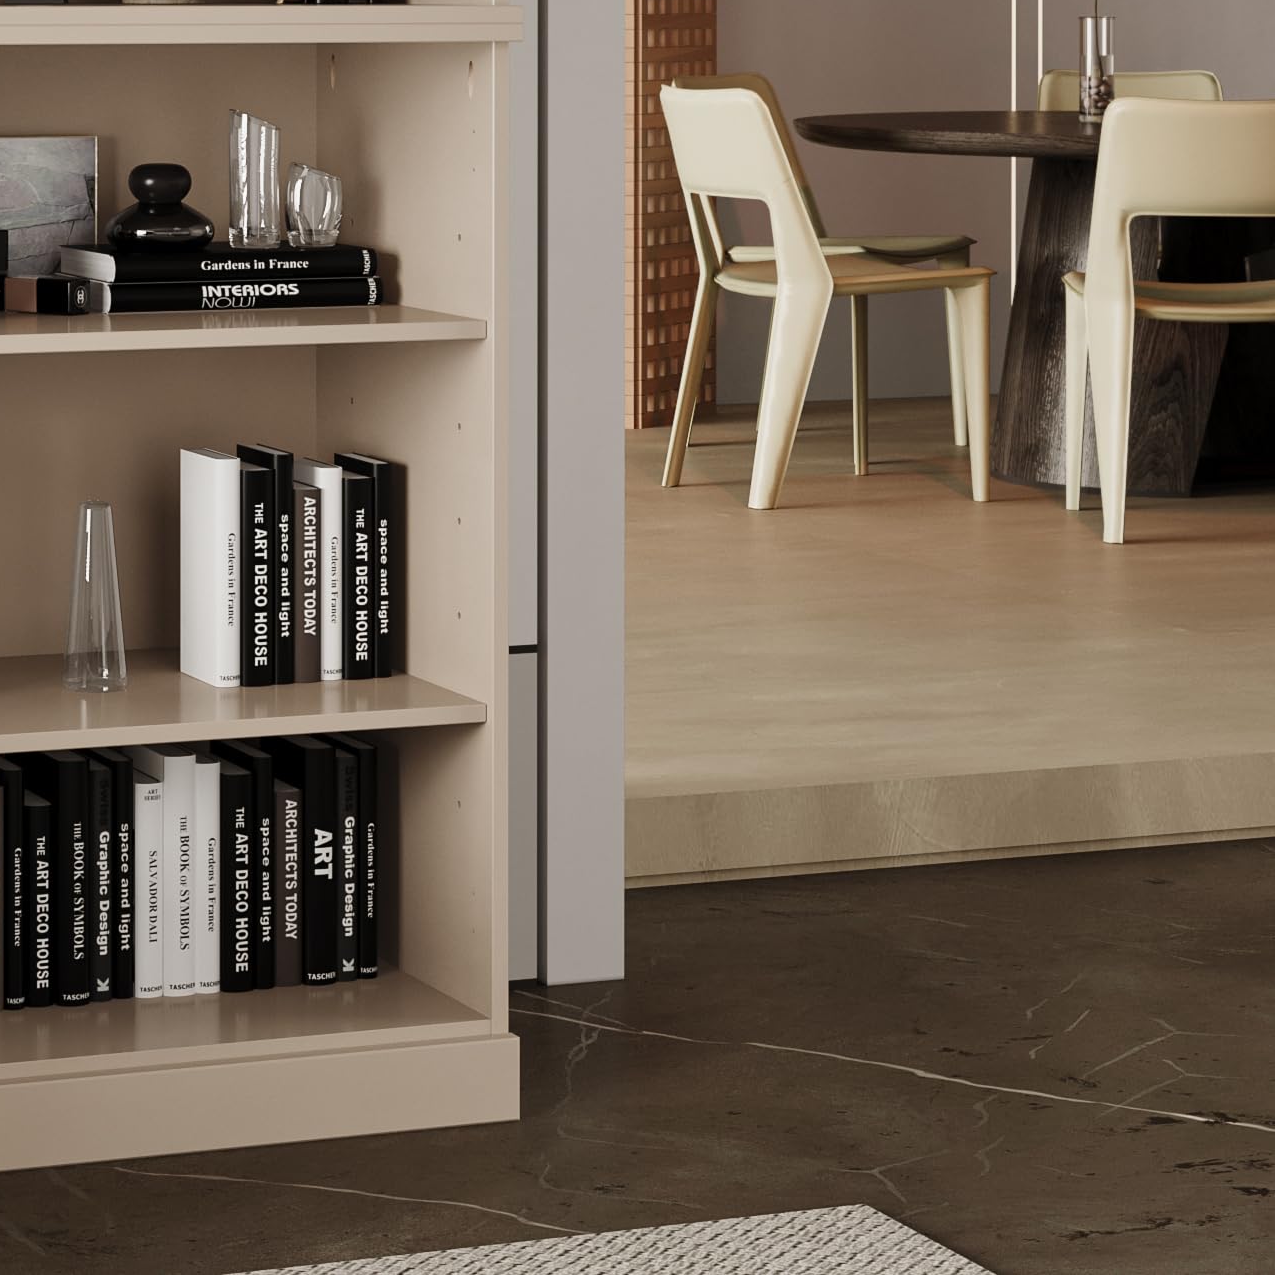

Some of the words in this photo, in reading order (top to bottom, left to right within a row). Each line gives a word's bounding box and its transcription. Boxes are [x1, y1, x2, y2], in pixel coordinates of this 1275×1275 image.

[201, 260, 251, 271] Gardens
[269, 258, 309, 269] France
[202, 283, 299, 297] INTERIORS
[254, 502, 263, 524] THE
[356, 508, 365, 528] THE
[228, 532, 236, 576] Gardens
[254, 529, 268, 559] ART
[279, 514, 289, 563] space
[304, 496, 316, 586] ARCHITECTS
[356, 533, 368, 561] ART
[378, 519, 388, 565] space
[254, 565, 268, 607] DECO
[281, 568, 290, 597] and
[356, 566, 368, 606] DECO
[380, 569, 388, 597] and
[228, 592, 236, 626] France
[279, 601, 290, 637] light
[304, 589, 316, 636] TODAY
[378, 600, 388, 634] light
[254, 612, 268, 667] HOUSE
[356, 611, 368, 661] HOUSE
[236, 807, 244, 829] THE
[37, 836, 45, 855] THE
[74, 842, 84, 879] BOOK
[96, 830, 110, 896] Graphic
[118, 823, 128, 873] space
[180, 835, 190, 871] BOOK
[208, 837, 216, 880] Gardens
[236, 833, 248, 864] ART
[285, 799, 298, 889] ARCHITECTS
[314, 828, 333, 880] ART
[342, 816, 355, 879] Graphic
[37, 860, 49, 889] ART
[120, 878, 130, 908] and
[148, 850, 157, 915] SALVADOR
[236, 870, 248, 913] DECO
[37, 894, 49, 934] DECO
[74, 897, 84, 960] SYMBOLS
[96, 900, 110, 956] Design
[180, 890, 190, 951] SYMBOLS
[208, 896, 216, 932] France
[285, 892, 298, 940] TODAY
[342, 883, 355, 937] Design
[118, 913, 130, 950] light
[236, 917, 248, 973] HOUSE
[37, 938, 49, 989] HOUSE
